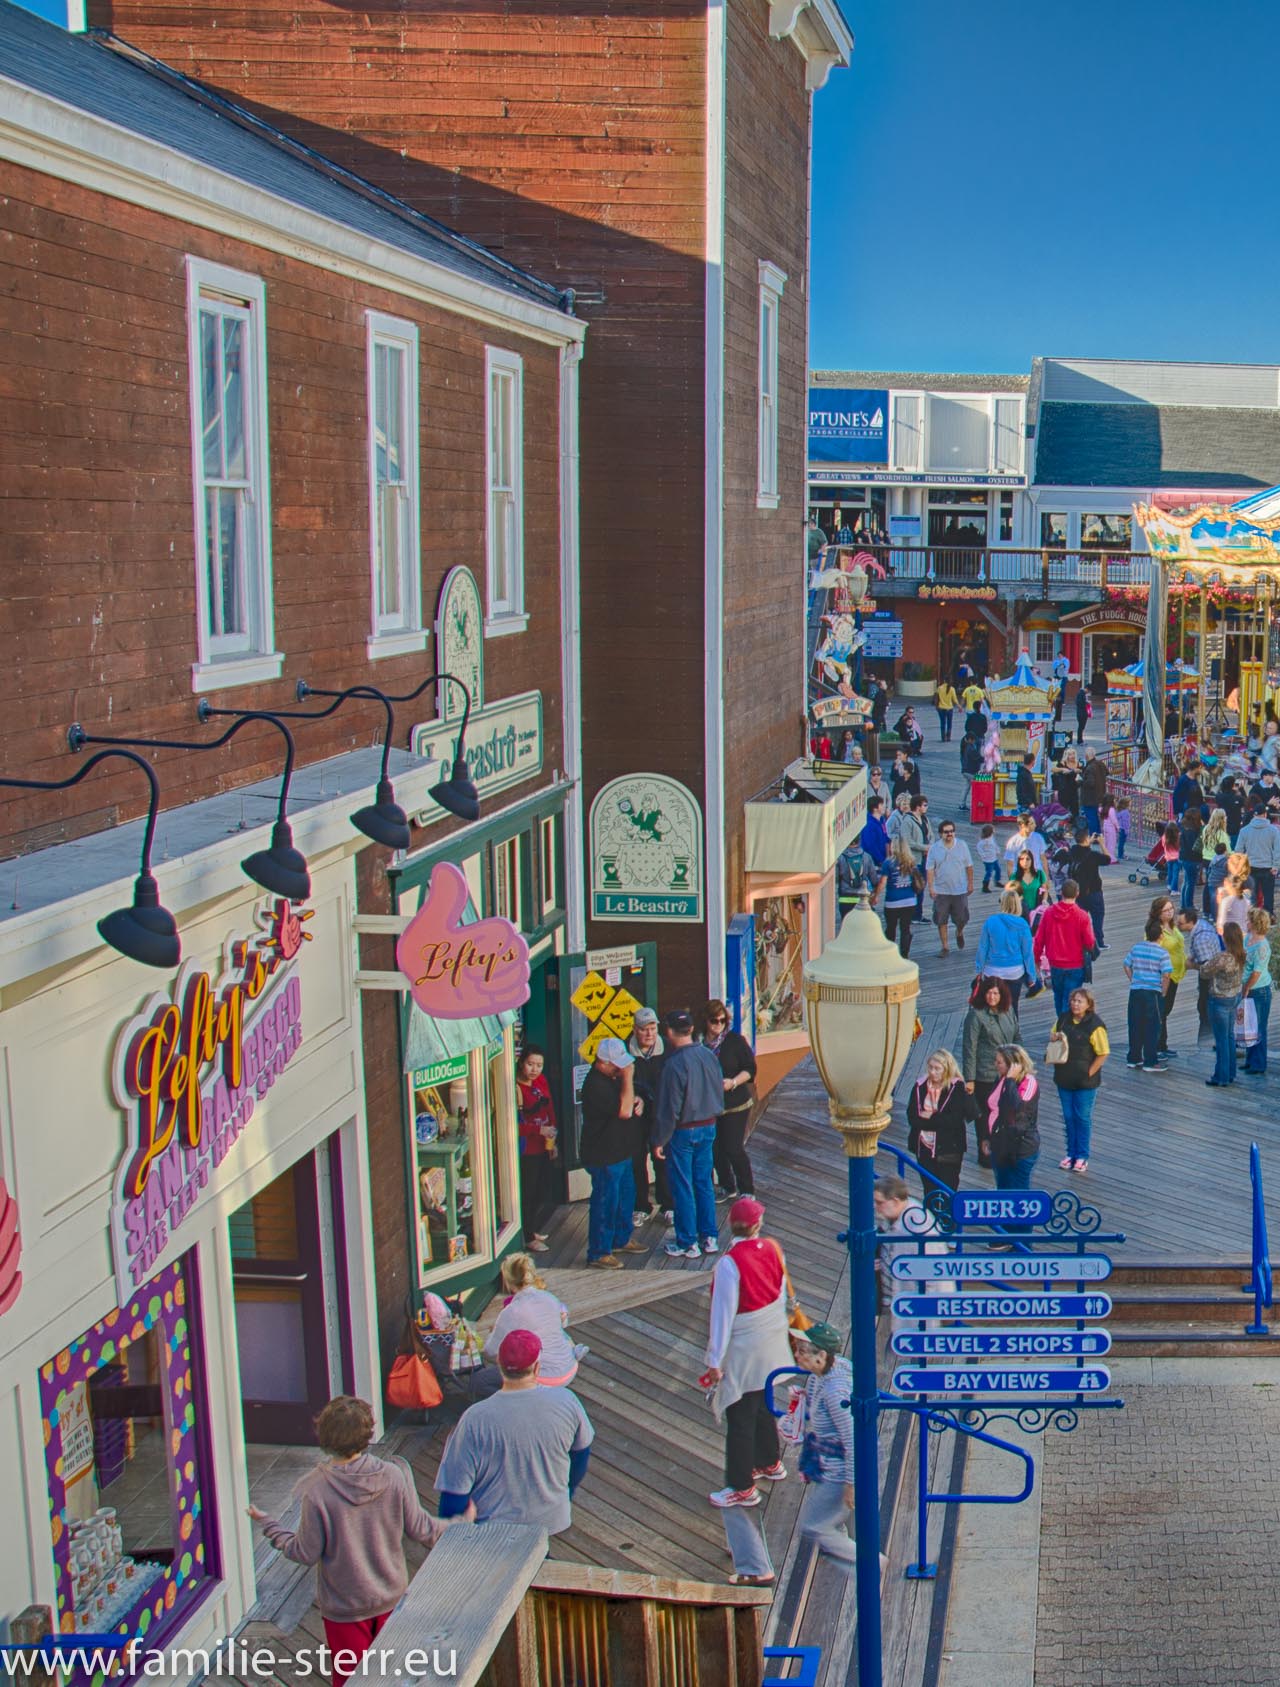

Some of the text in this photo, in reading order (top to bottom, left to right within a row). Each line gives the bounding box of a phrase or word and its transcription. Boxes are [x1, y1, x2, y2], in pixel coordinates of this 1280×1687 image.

[809, 411, 869, 428] PTUNE'S
[874, 474, 913, 482] SWORDFISH
[925, 475, 975, 483] FRESH SALMON
[988, 477, 1019, 485] OYSTERS
[1080, 609, 1147, 625] THE FUDGE HOUS
[605, 897, 625, 912] Le
[414, 941, 518, 988] Lefty's
[125, 940, 268, 1197] Lefty's
[416, 1062, 466, 1085] BULLDOG BLVD
[126, 976, 301, 1256] SAN RACISCO
[130, 1022, 302, 1286] THE LEFT HAND STORE
[964, 1199, 1041, 1218] PIER 39
[933, 1261, 1060, 1277] SWISS LOUIS
[937, 1299, 1061, 1315] RESTROOMS
[923, 1336, 1073, 1352] LEVEL 2 SHOPS
[943, 1373, 1050, 1389] BAY VIEWS
